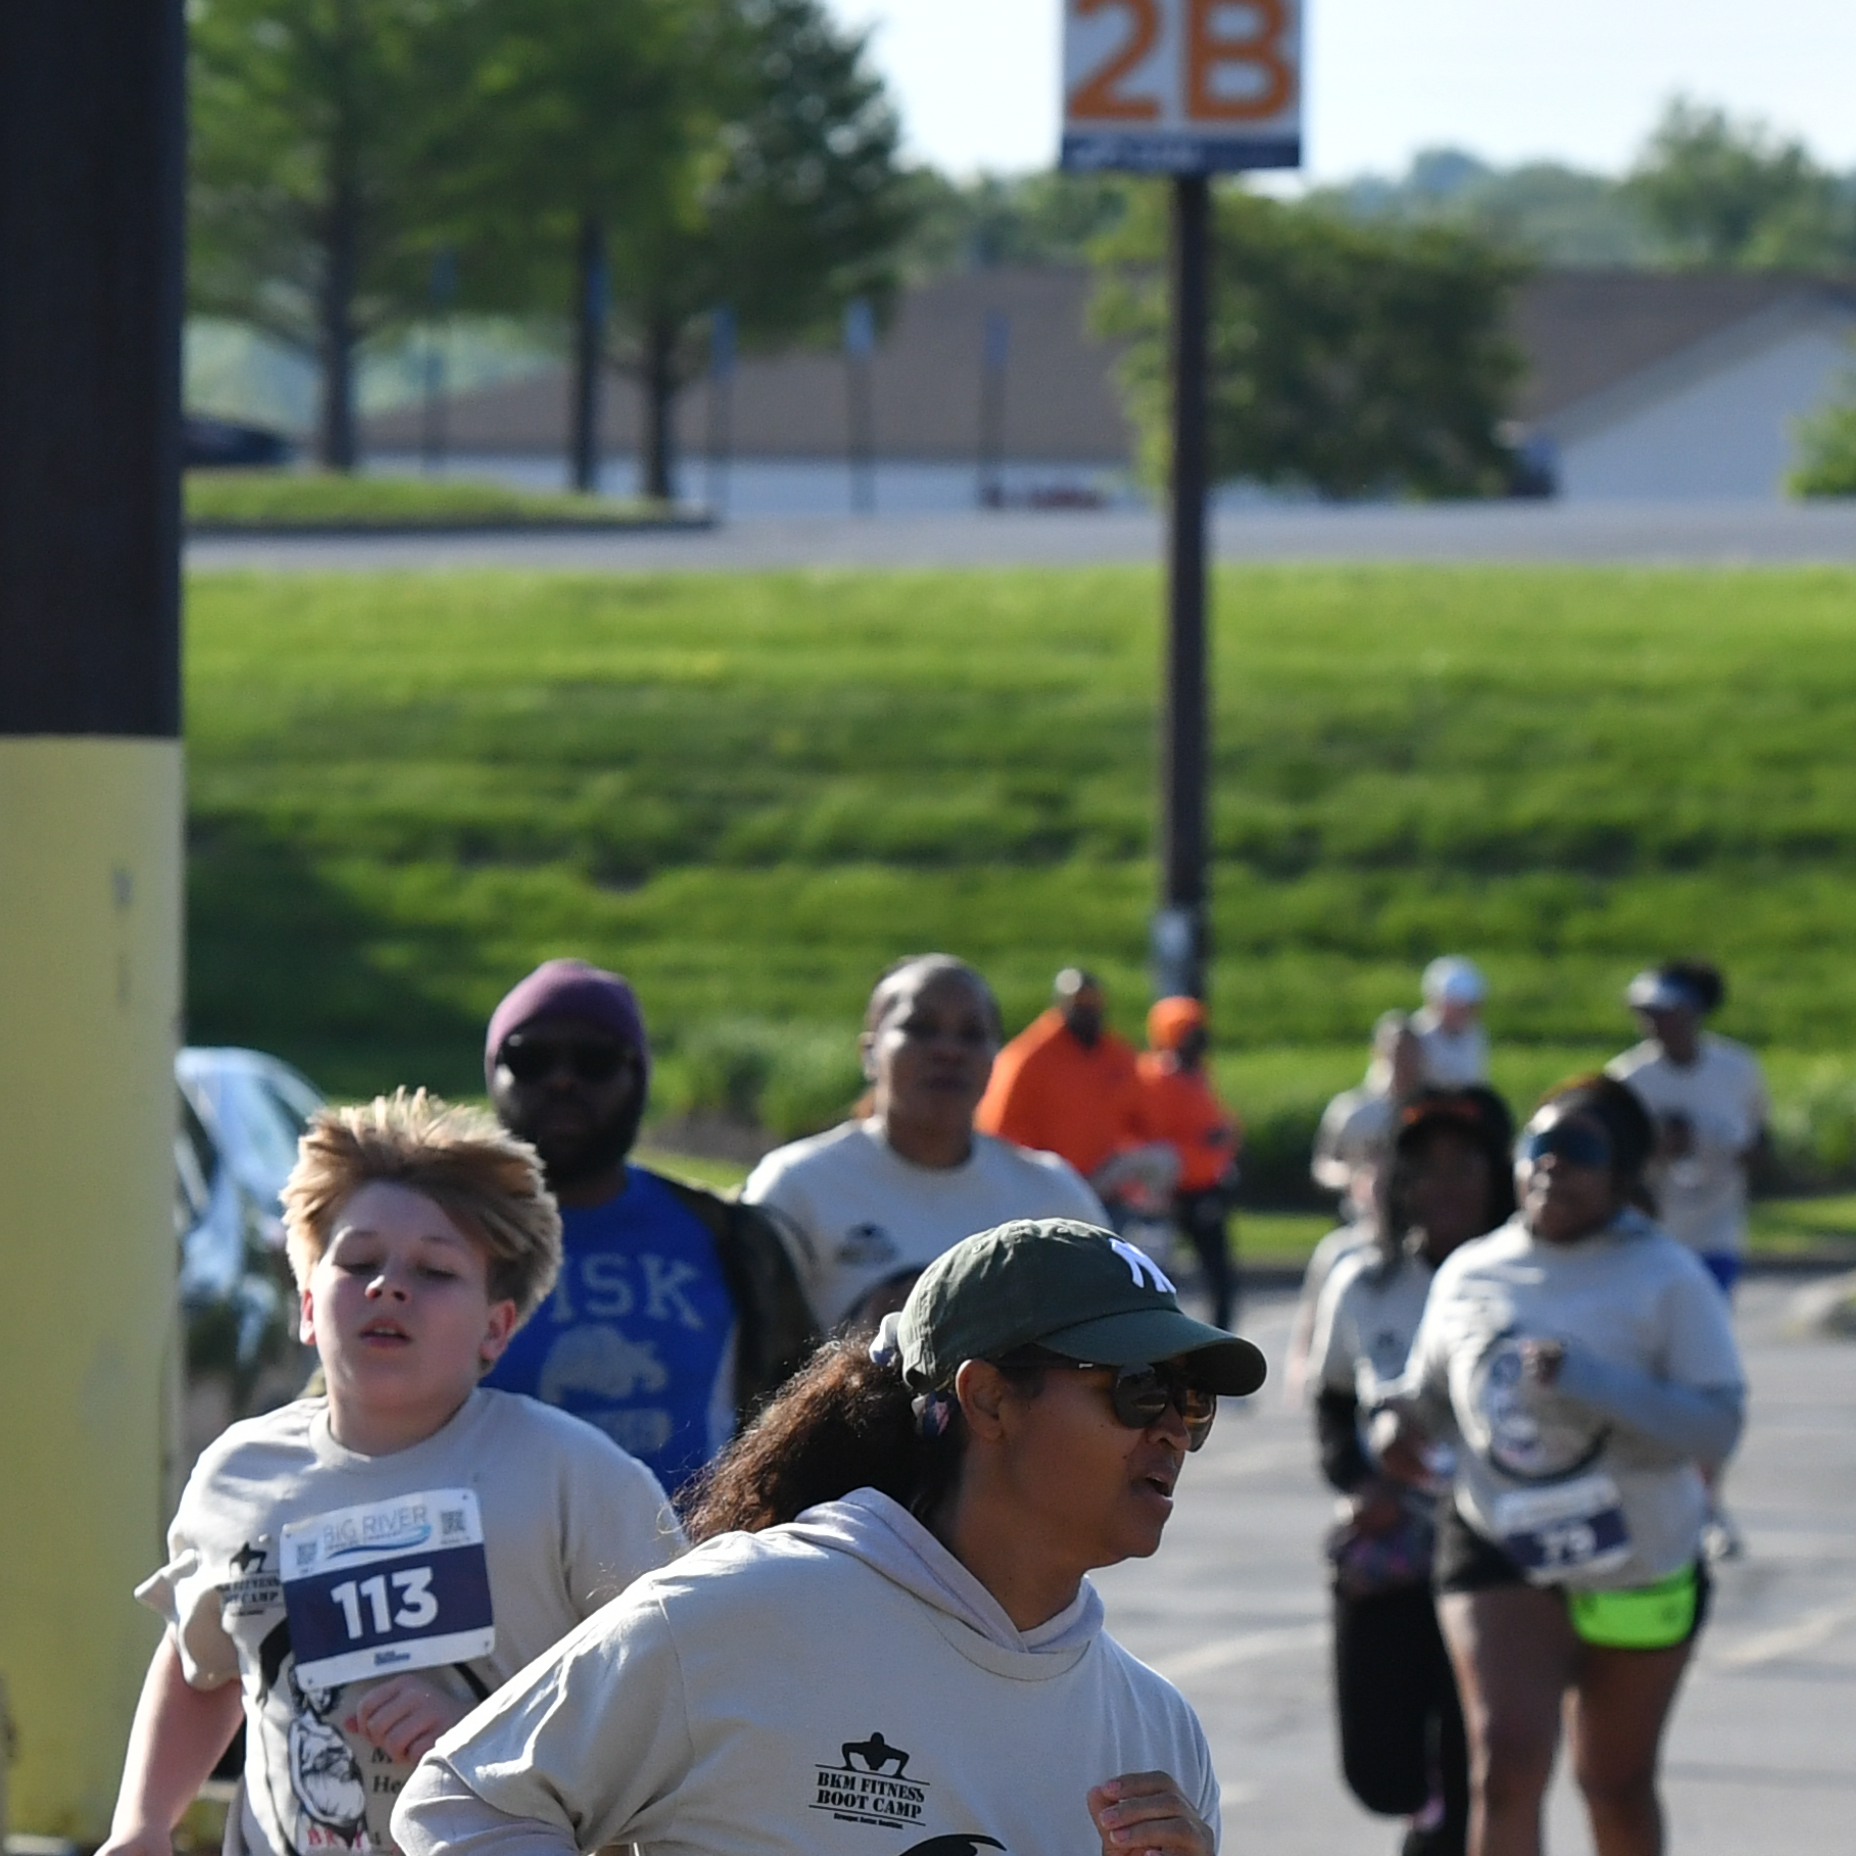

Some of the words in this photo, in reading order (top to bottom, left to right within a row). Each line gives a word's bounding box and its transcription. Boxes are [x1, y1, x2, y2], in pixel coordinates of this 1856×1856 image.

[1068, 0, 1291, 119] 2B
[323, 1518, 357, 1542] BIG
[363, 1504, 428, 1534] RIVER
[331, 1566, 438, 1640] 113
[816, 1789, 870, 1809] BOOT
[873, 1797, 922, 1818] CAMP
[817, 1772, 856, 1790] BKM
[861, 1778, 925, 1803] FITNESS
